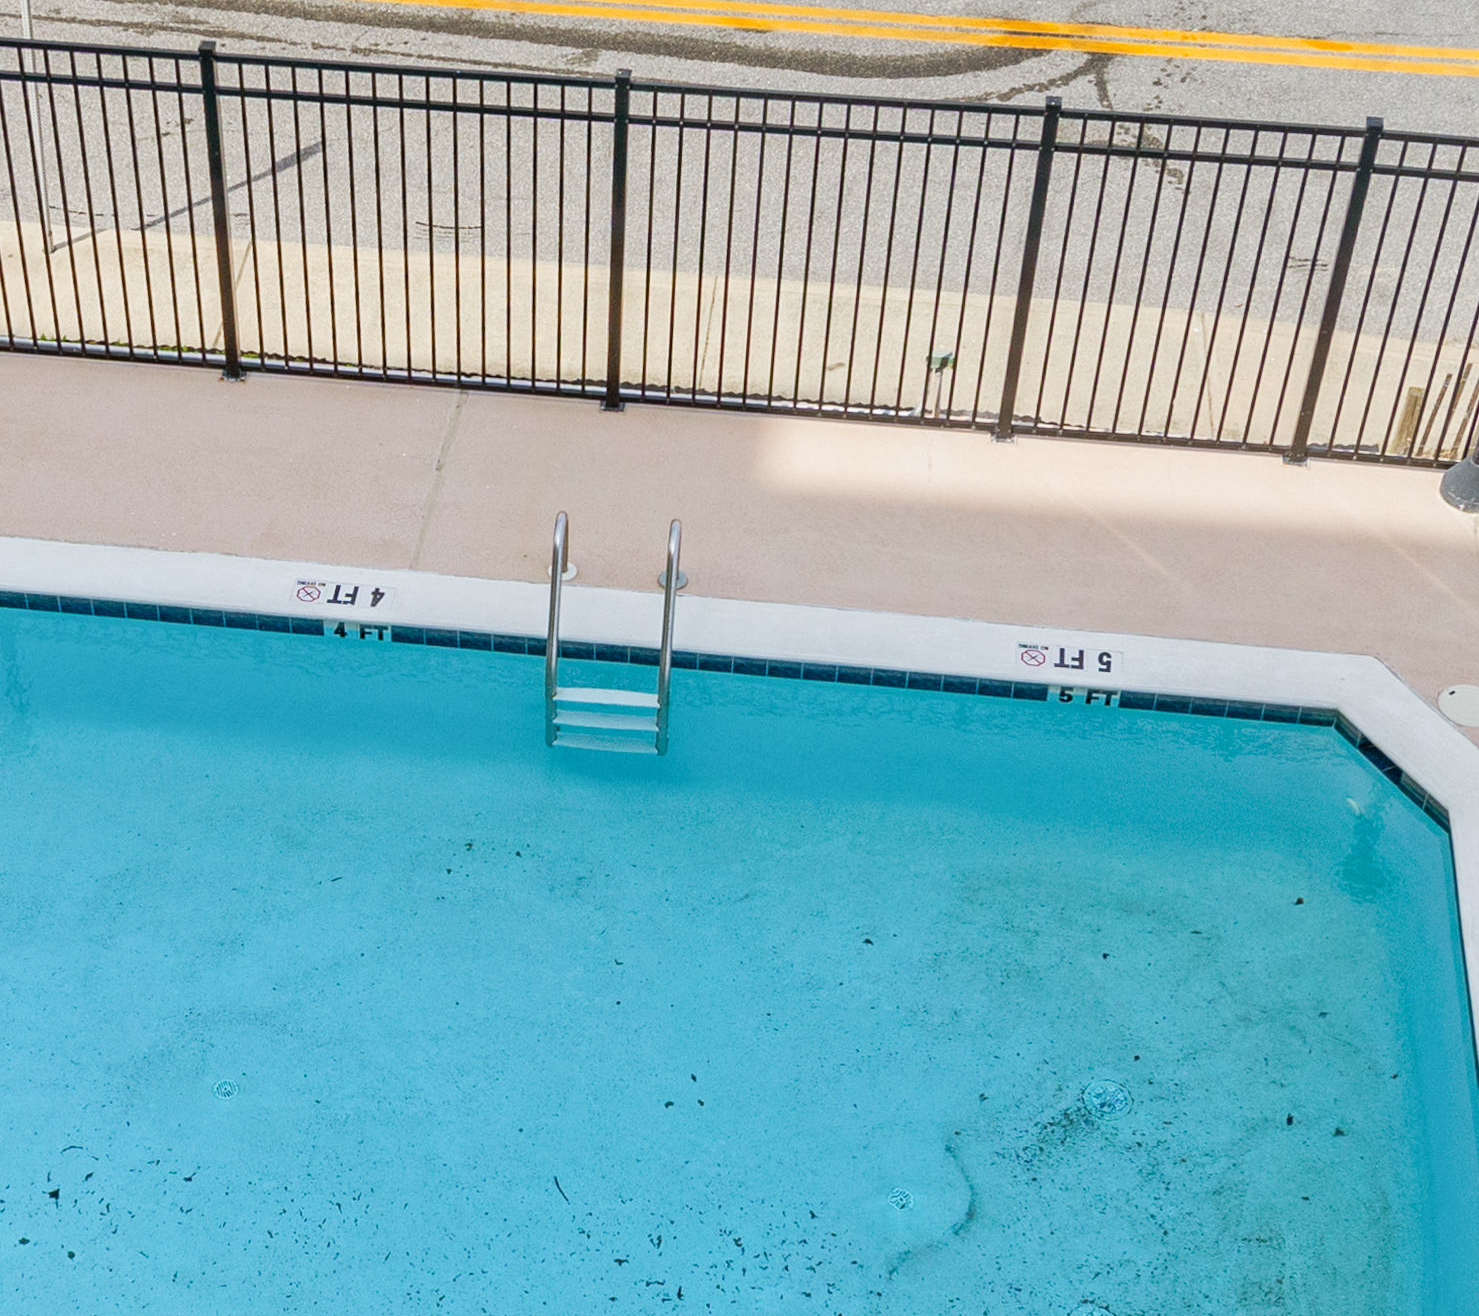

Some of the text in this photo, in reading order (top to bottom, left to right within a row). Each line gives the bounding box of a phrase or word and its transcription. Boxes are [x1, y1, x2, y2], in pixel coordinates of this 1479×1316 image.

[326, 585, 385, 607] 4 FT
[334, 621, 388, 641] 4 FT
[1054, 647, 1112, 673] 5 FT
[1058, 687, 1118, 706] 5 FT
